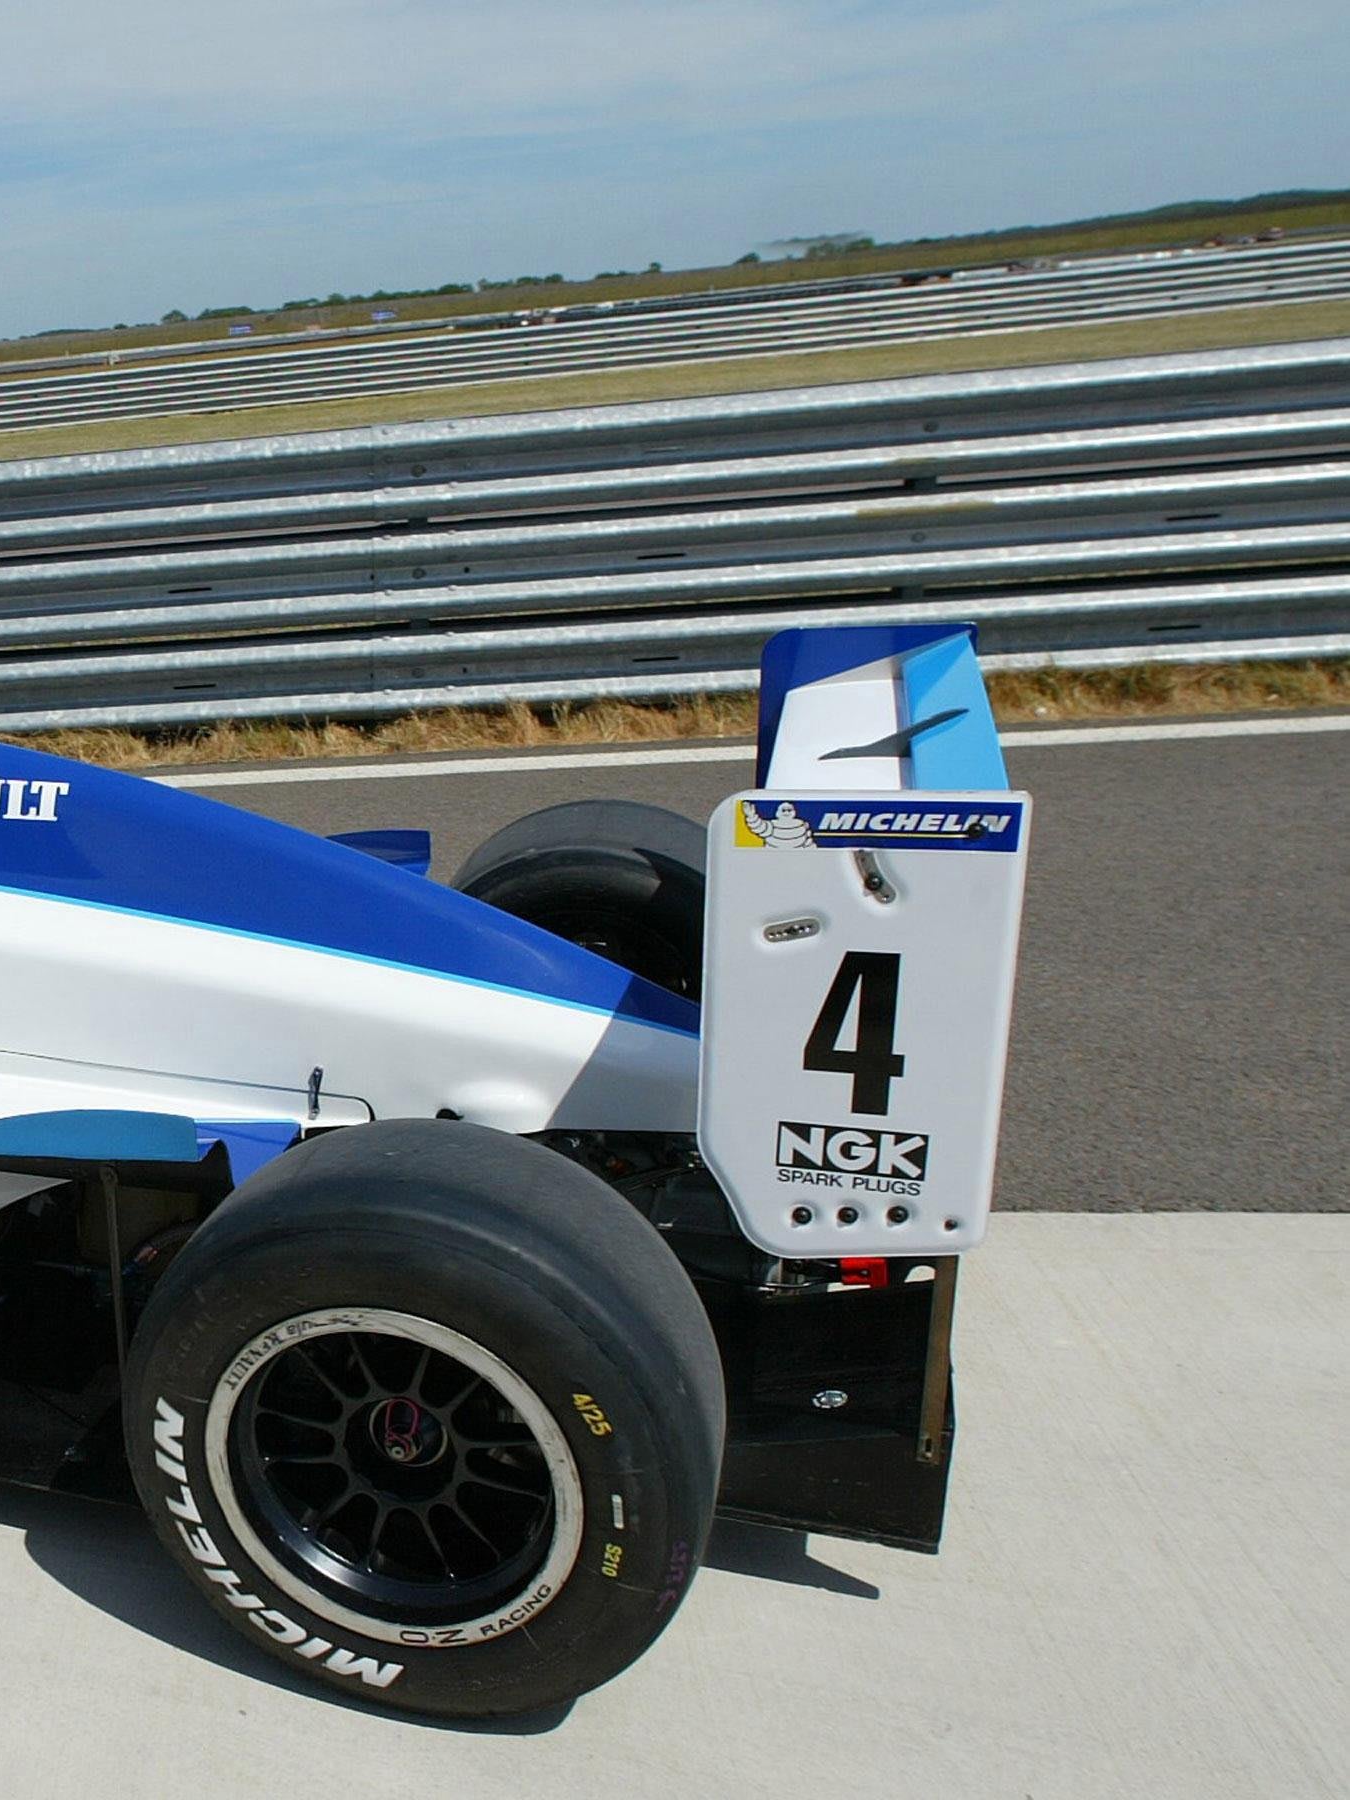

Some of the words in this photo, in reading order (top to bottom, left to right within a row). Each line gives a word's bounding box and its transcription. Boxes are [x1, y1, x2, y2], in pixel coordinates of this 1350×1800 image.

[803, 950, 905, 1117] 4
[779, 1124, 927, 1178] NGK
[777, 1168, 843, 1189] SPARK
[852, 1175, 922, 1197] PLUGS
[154, 1396, 405, 1688] MICHELIN
[479, 1583, 553, 1636] RACING
